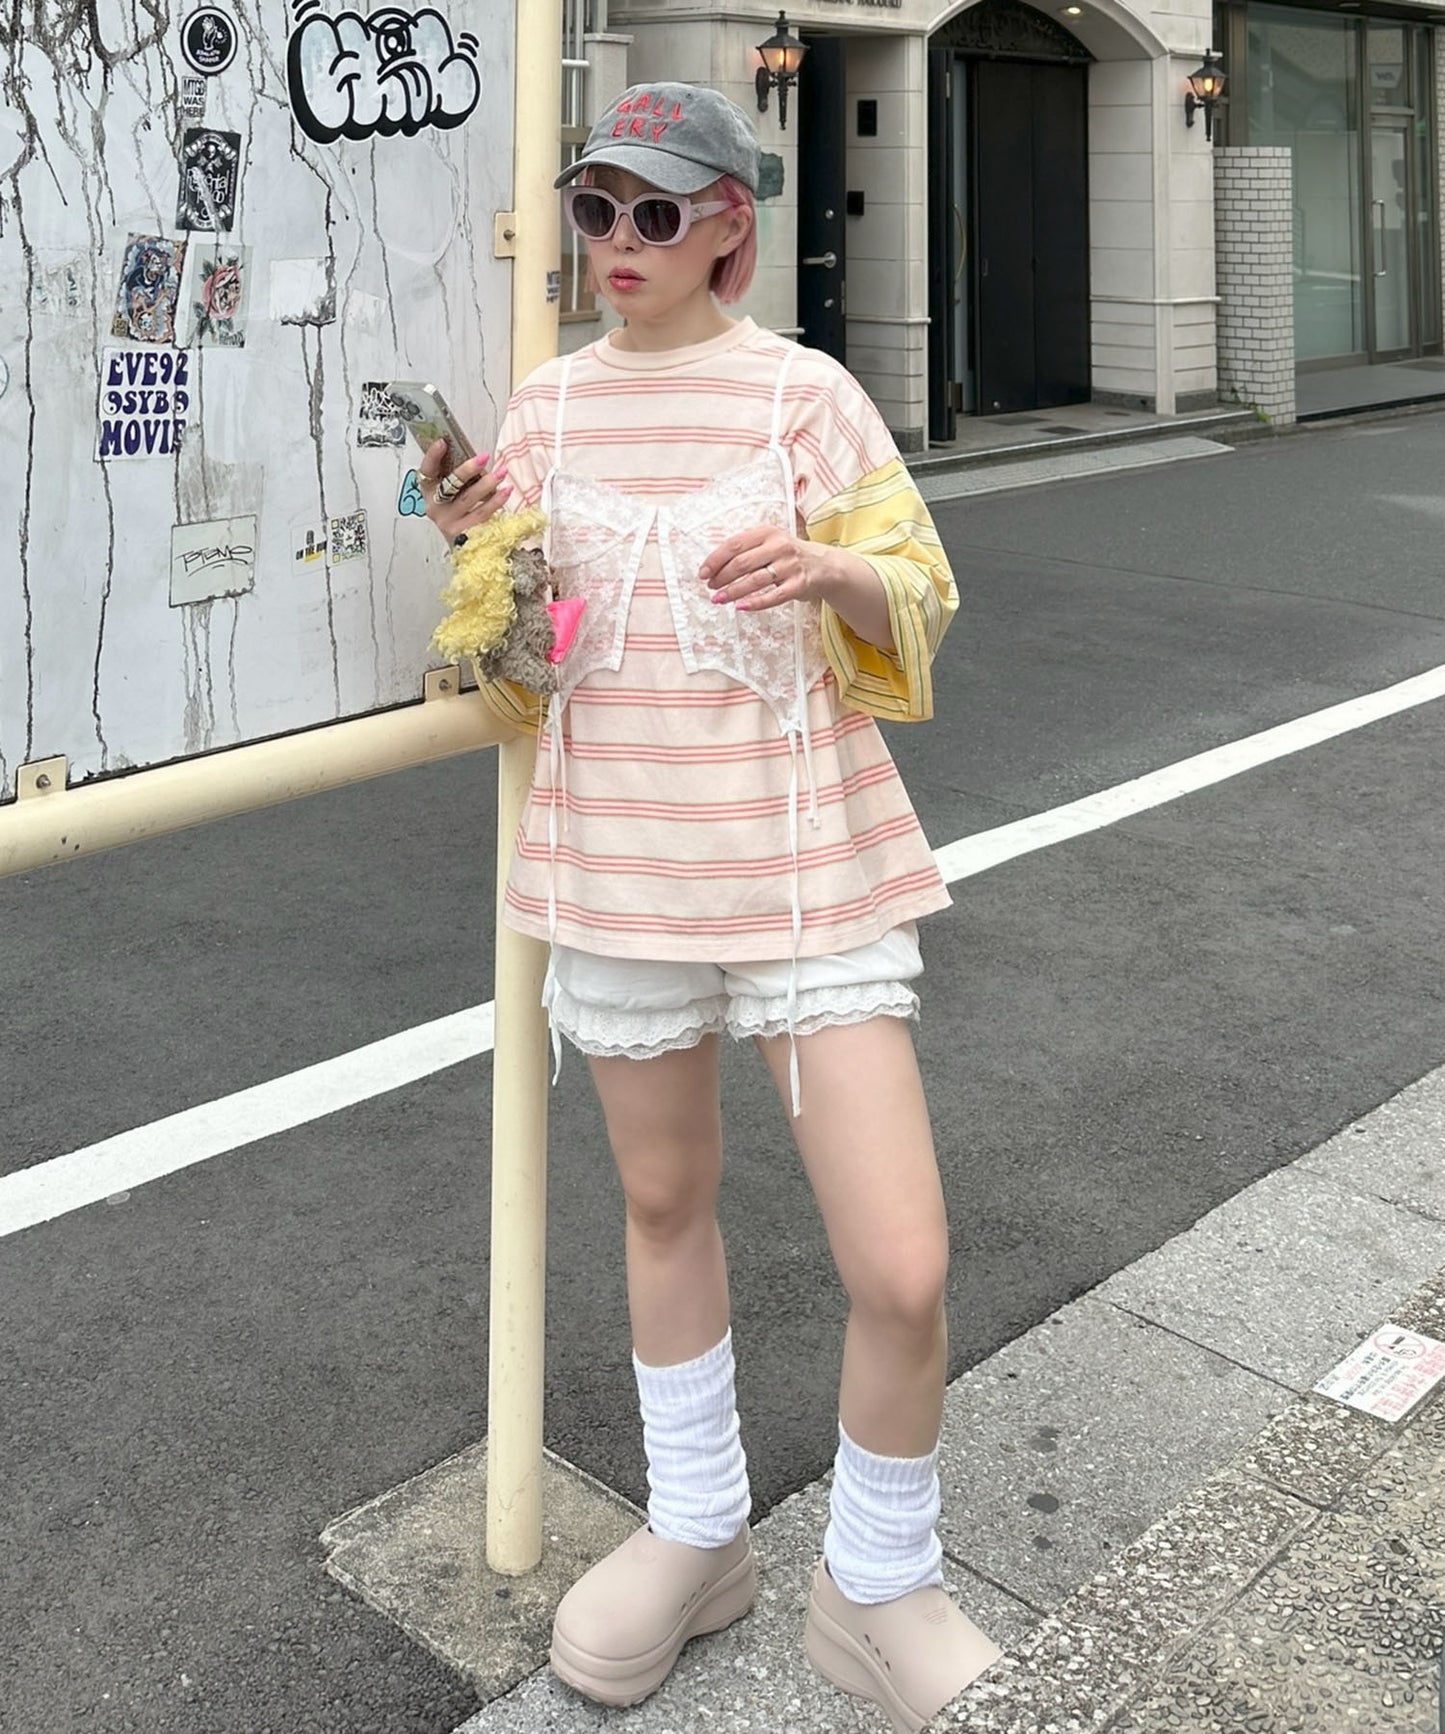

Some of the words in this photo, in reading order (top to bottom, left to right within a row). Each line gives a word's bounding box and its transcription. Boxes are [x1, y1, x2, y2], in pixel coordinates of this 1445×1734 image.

[183, 97, 206, 106] WAS
[616, 92, 684, 121] GALL
[611, 116, 668, 144] ERY
[107, 352, 188, 386] EVE92
